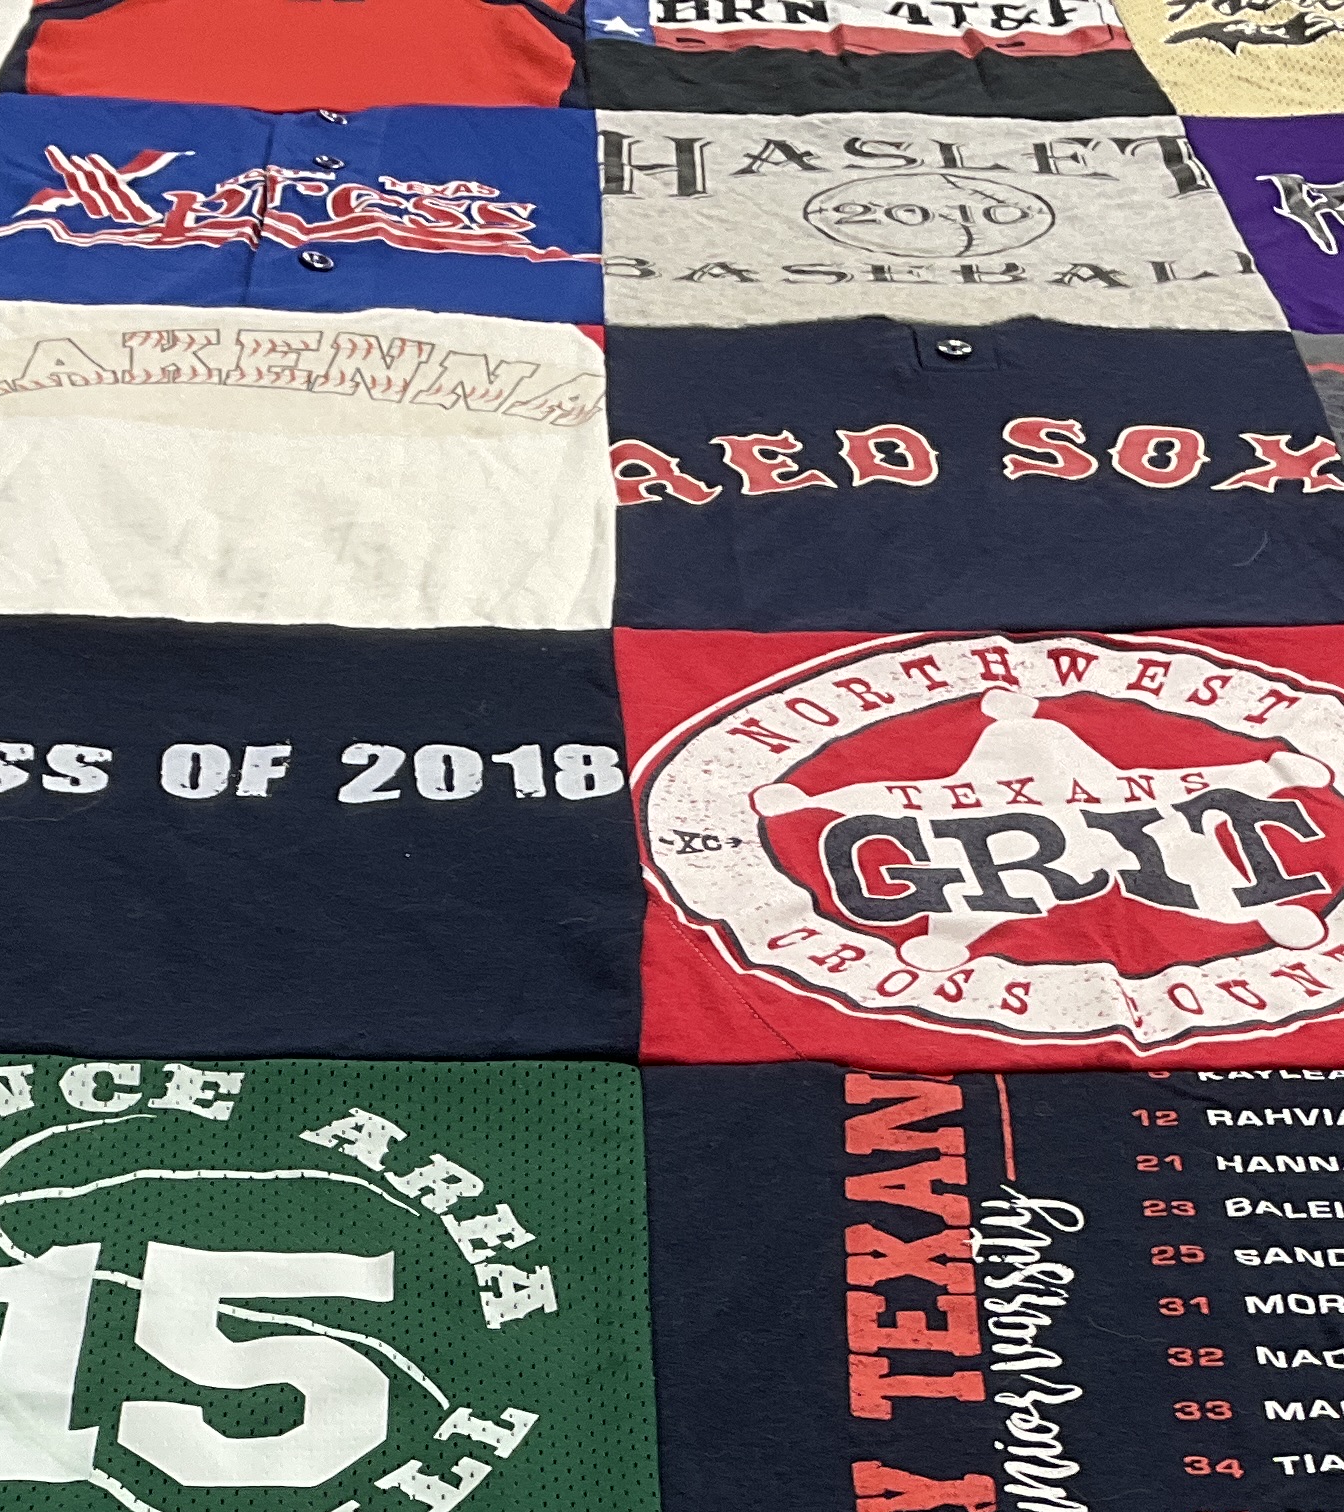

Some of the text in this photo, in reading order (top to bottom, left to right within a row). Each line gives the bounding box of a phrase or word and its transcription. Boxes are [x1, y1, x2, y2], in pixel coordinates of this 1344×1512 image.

[596, 129, 1218, 199] HASLET
[830, 200, 1033, 228] 2010
[607, 423, 940, 505] RED
[726, 642, 1303, 756] NORTHWEST
[157, 739, 294, 801] OF
[336, 739, 628, 806] 2018
[885, 770, 1215, 811] TEXANS
[818, 786, 1336, 924] GRIT
[764, 925, 1034, 1016] CROSS
[1132, 1108, 1179, 1128] 12
[1136, 1154, 1184, 1173] 21
[297, 1106, 559, 1331] AREA
[1142, 1199, 1197, 1218] 23
[844, 1071, 987, 1421] TEXAN
[1150, 1243, 1206, 1266] 25
[968, 1183, 1085, 1372] varsity
[1158, 1295, 1210, 1317] 31
[1167, 1346, 1225, 1368] 32
[1173, 1399, 1234, 1421] 33
[1183, 1454, 1245, 1480] 34
